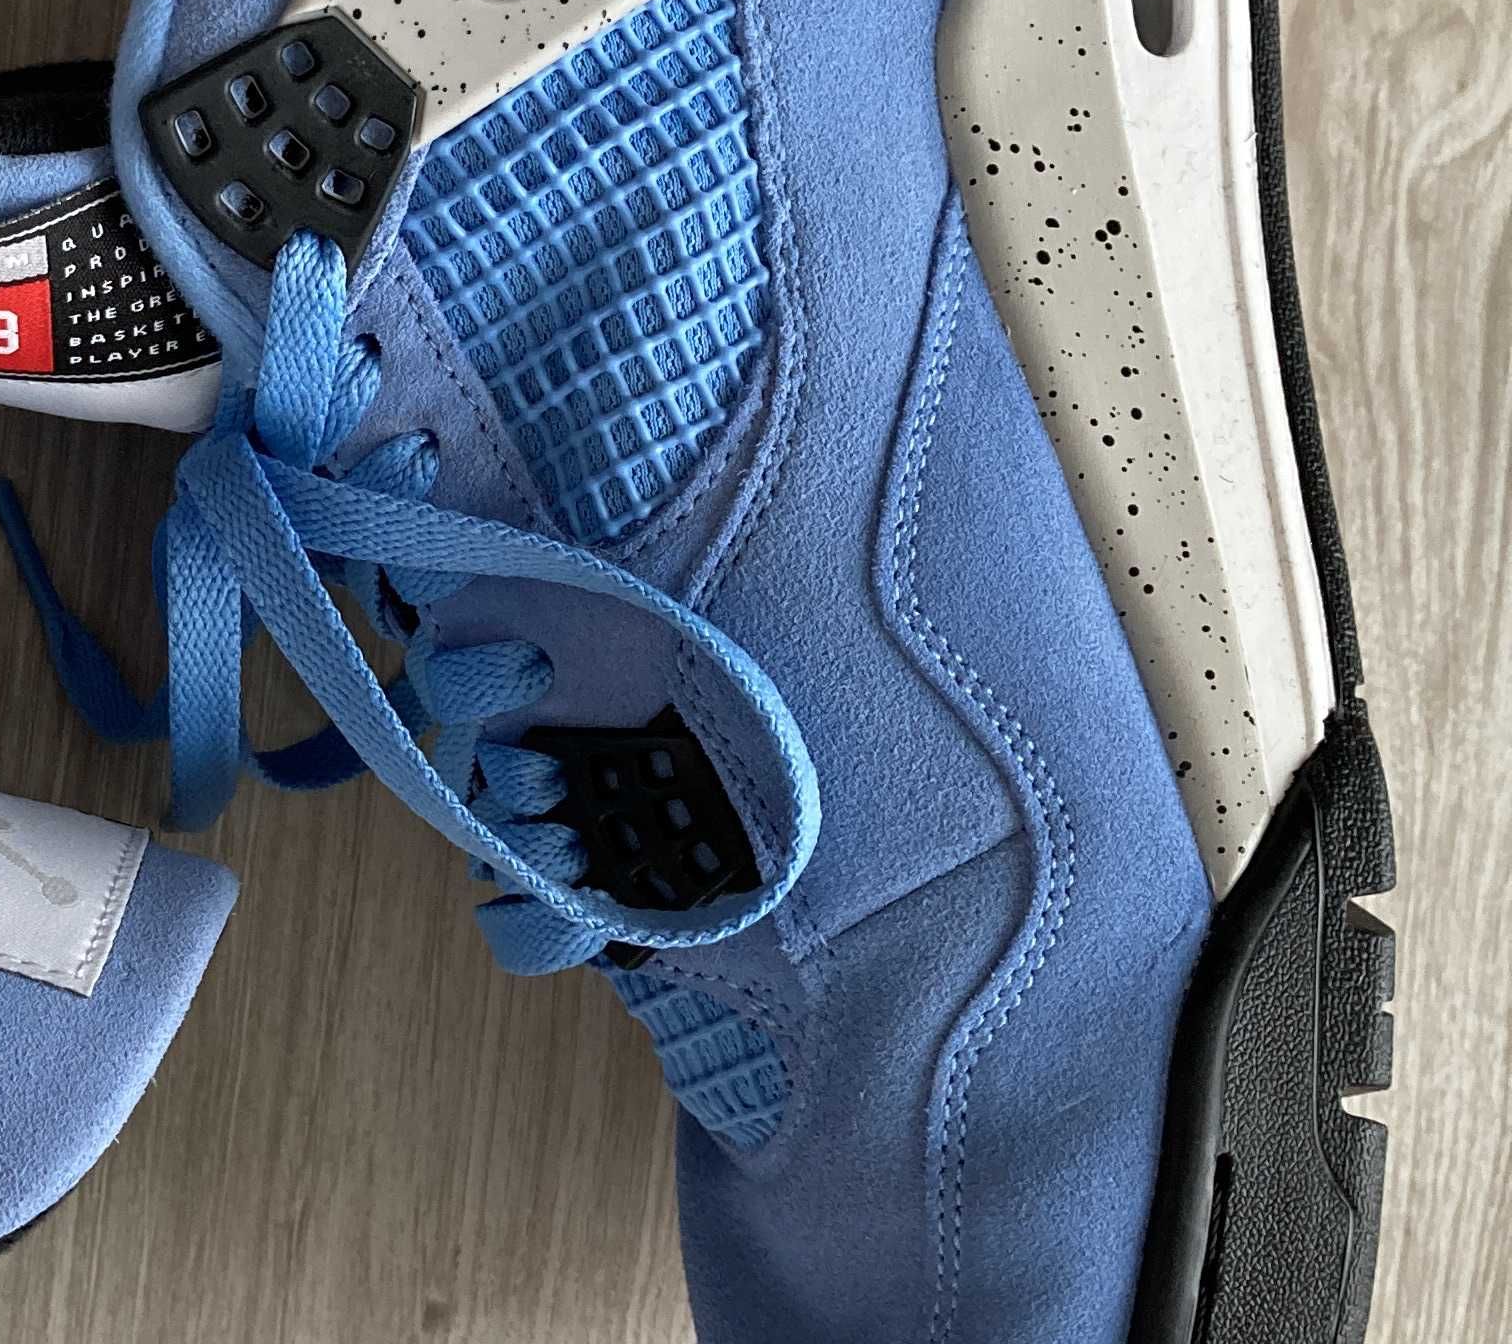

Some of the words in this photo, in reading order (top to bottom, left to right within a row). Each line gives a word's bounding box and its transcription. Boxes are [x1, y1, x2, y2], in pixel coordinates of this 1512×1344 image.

[68, 307, 118, 325] THE
[130, 288, 183, 313] GRE
[69, 340, 179, 365] PLAYER
